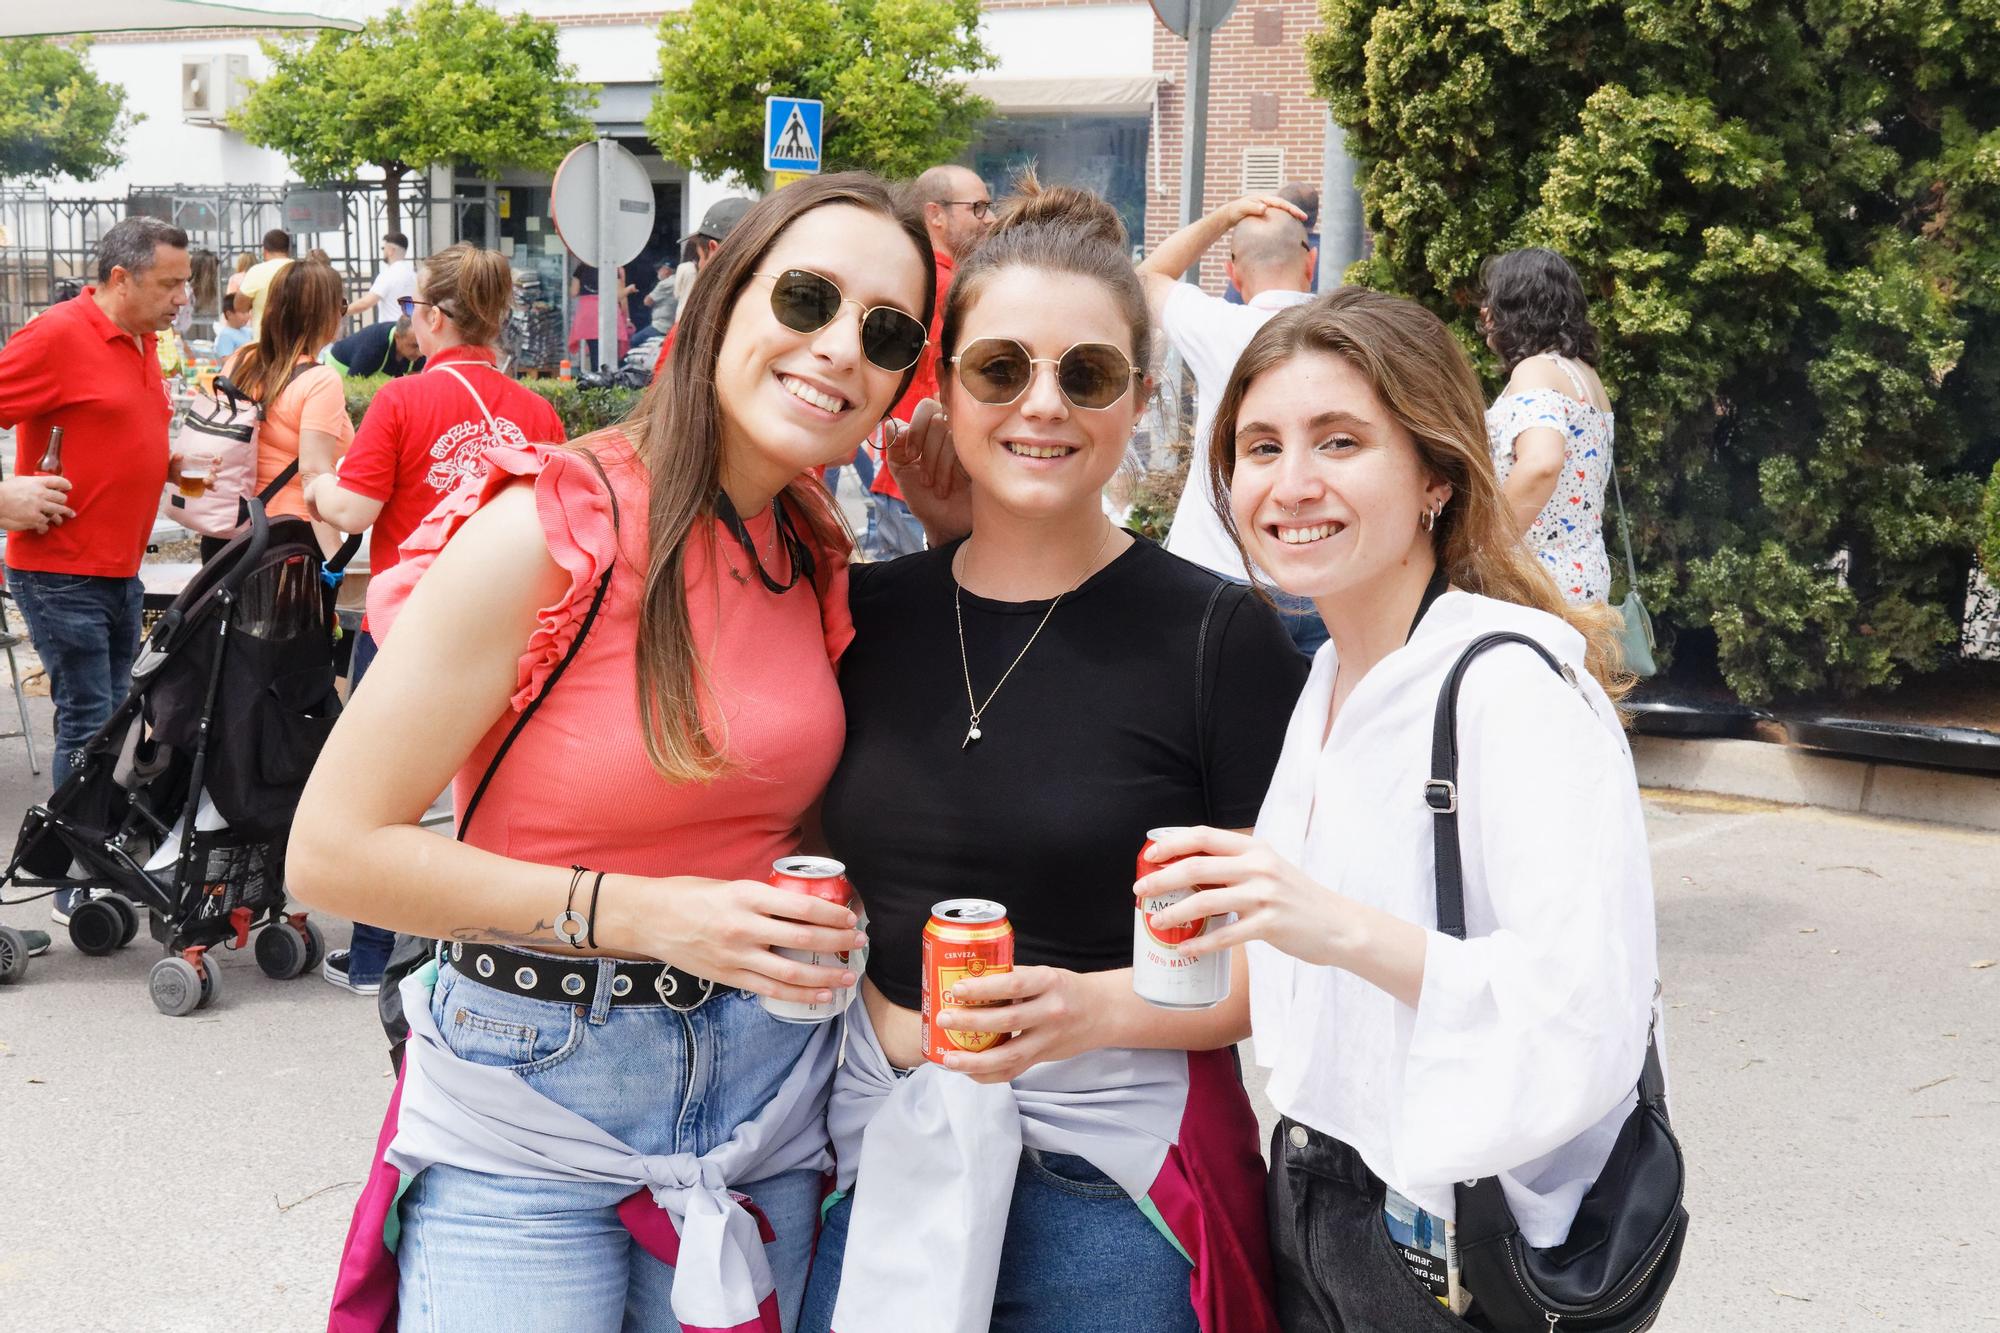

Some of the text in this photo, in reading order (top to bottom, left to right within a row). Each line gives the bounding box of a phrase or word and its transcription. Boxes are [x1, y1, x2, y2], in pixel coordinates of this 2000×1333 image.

[944, 951, 977, 960] CERVEZA
[1146, 951, 1200, 968] 100% MALTA
[1429, 1273, 1445, 1283] sus
